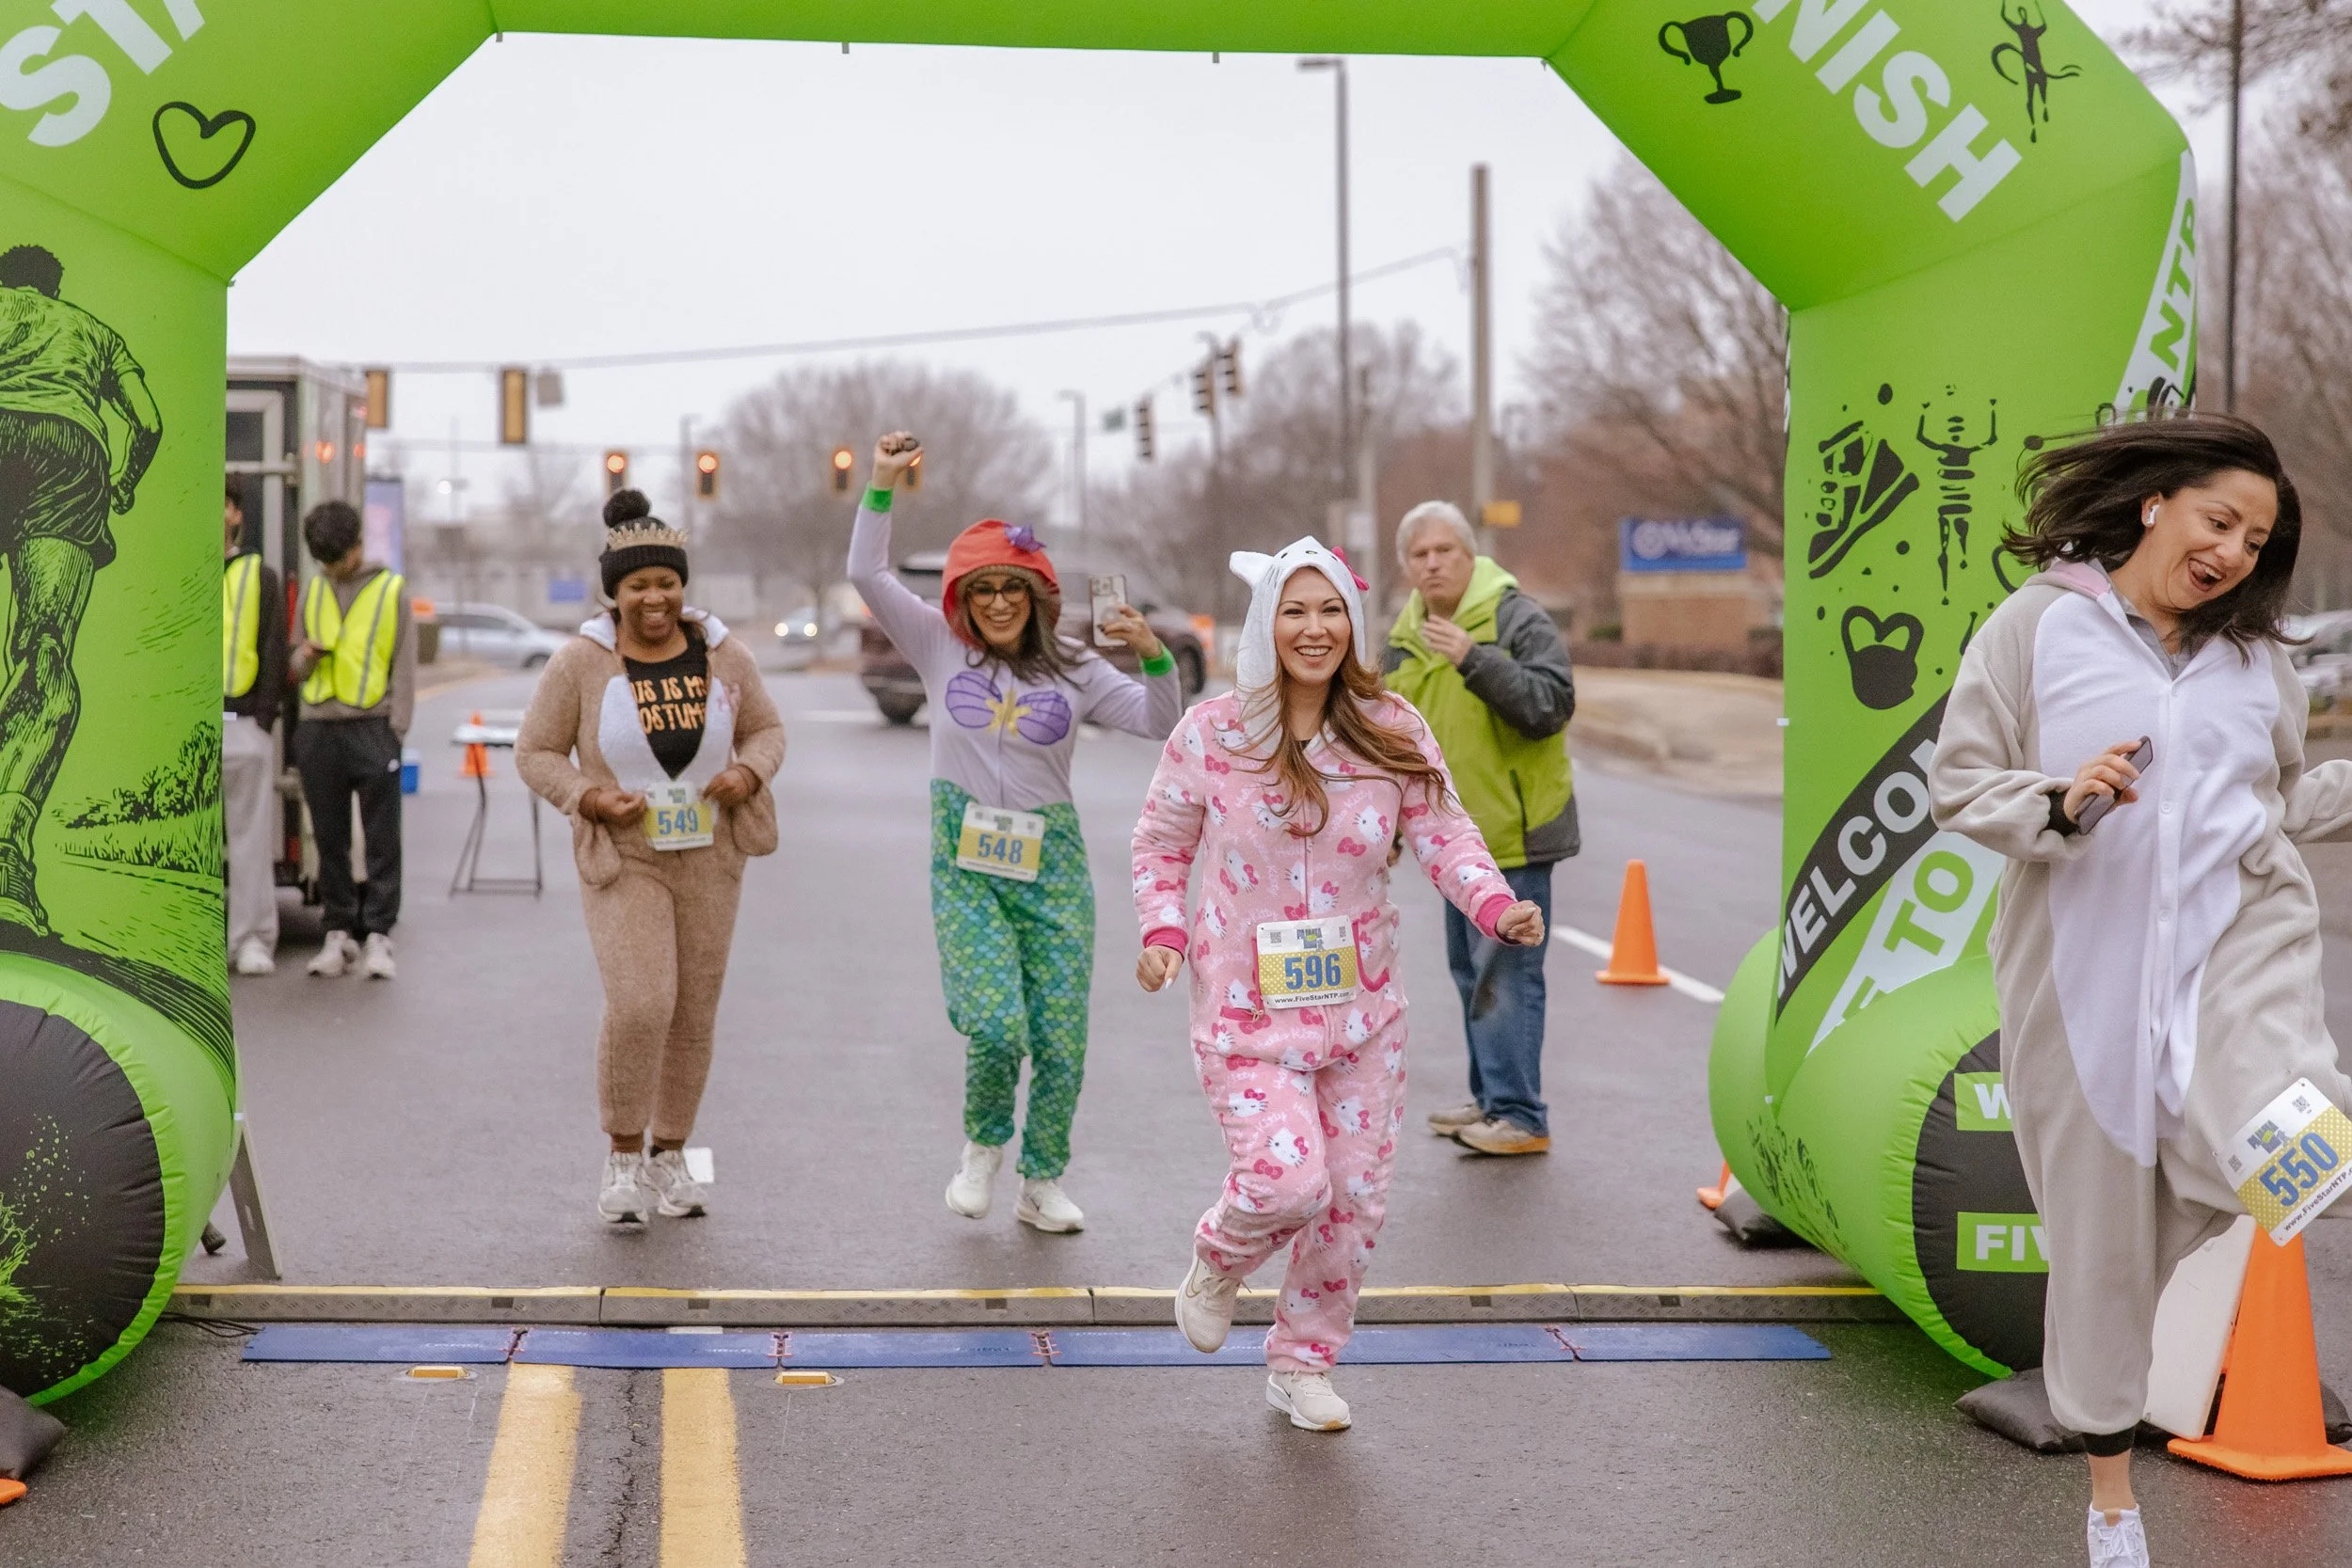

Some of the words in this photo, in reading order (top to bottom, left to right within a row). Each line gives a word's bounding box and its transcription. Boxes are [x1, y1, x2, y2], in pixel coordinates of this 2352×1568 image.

[0, 0, 205, 147] ST
[2149, 198, 2195, 373] NTP
[630, 679, 657, 704] IS
[660, 677, 683, 701] IS
[683, 675, 707, 698] M
[659, 809, 699, 835] 549
[978, 833, 1024, 864] 548
[1777, 738, 1936, 999] WELCO
[1883, 850, 1974, 957] TO
[1284, 953, 1342, 990] 596
[2259, 1132, 2340, 1208] 550
